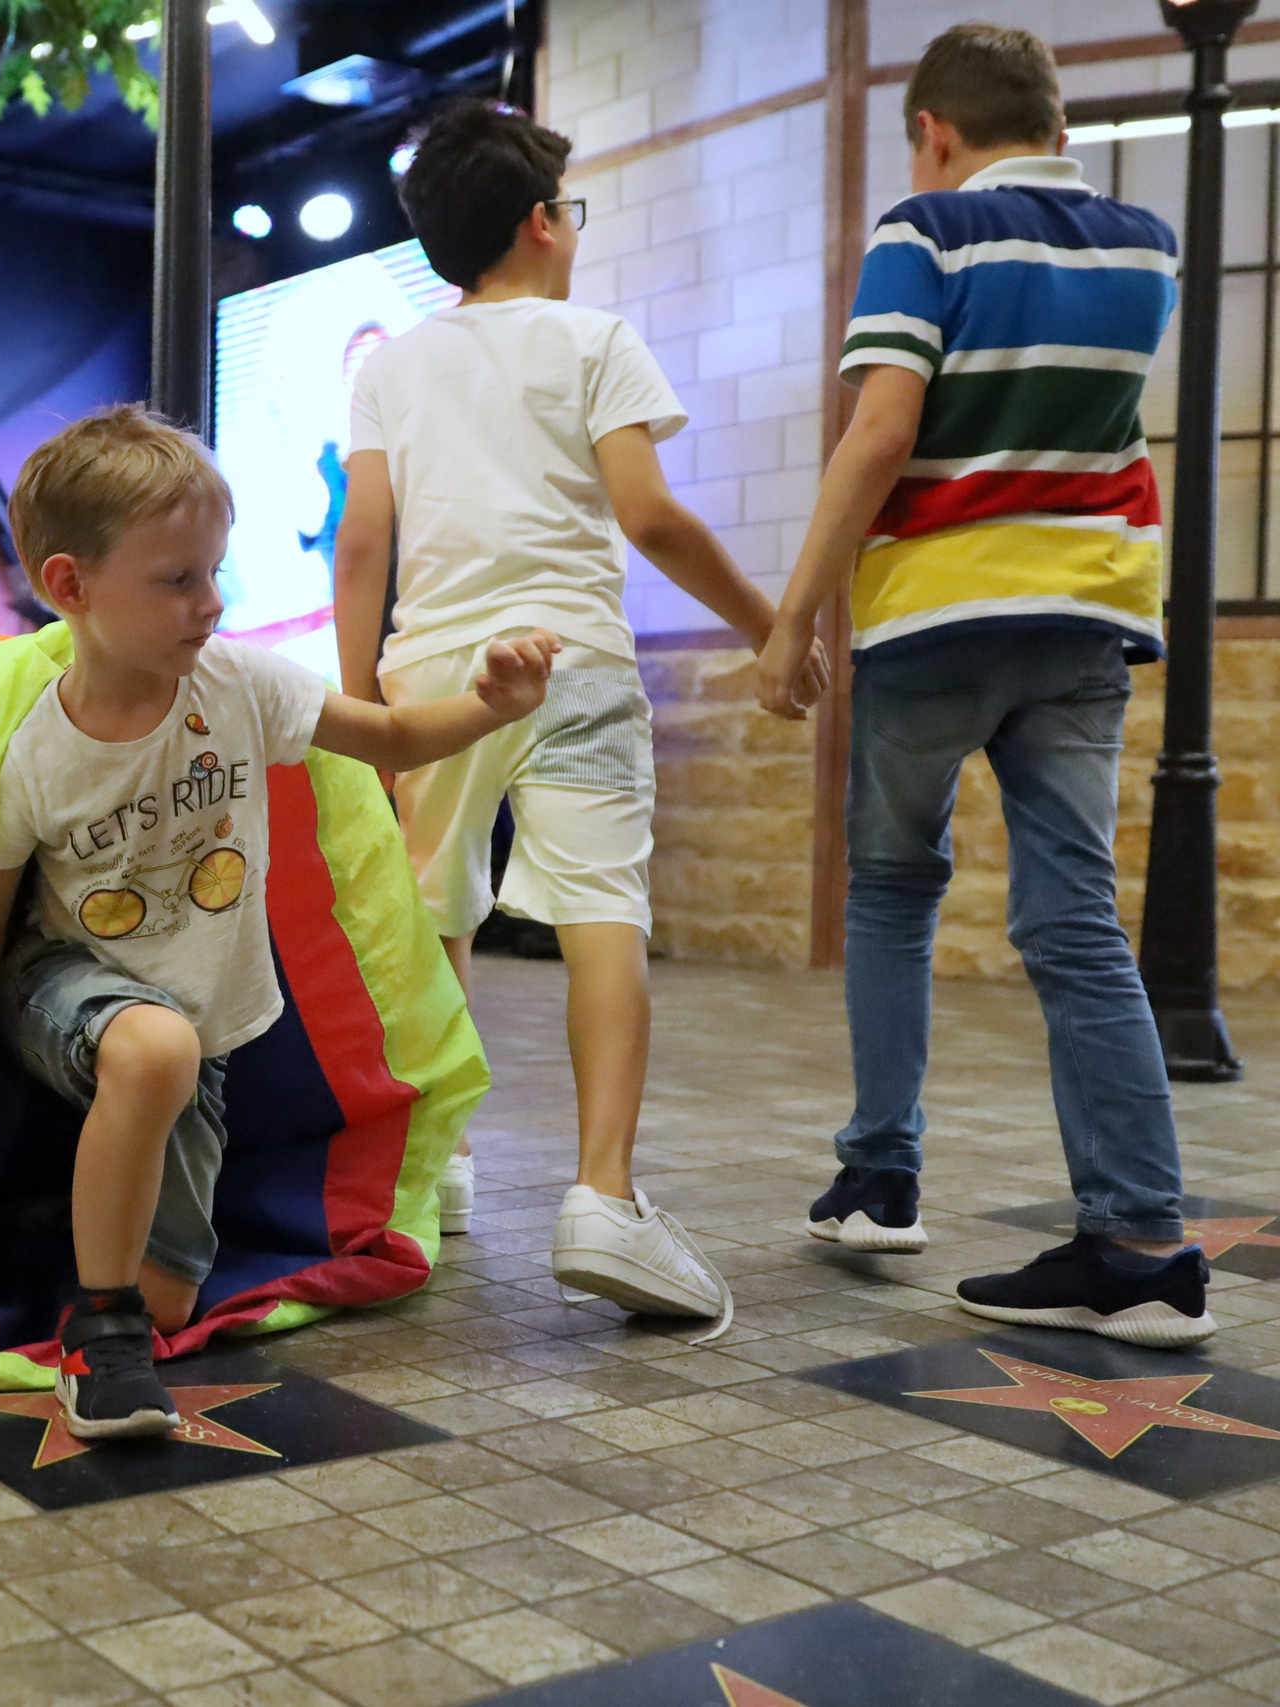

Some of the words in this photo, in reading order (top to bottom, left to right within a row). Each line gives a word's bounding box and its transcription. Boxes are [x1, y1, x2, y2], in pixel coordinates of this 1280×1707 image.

[69, 793, 159, 860] LET'S
[172, 760, 250, 817] RIDE
[1009, 1364, 1088, 1390] ЮЛИЯ
